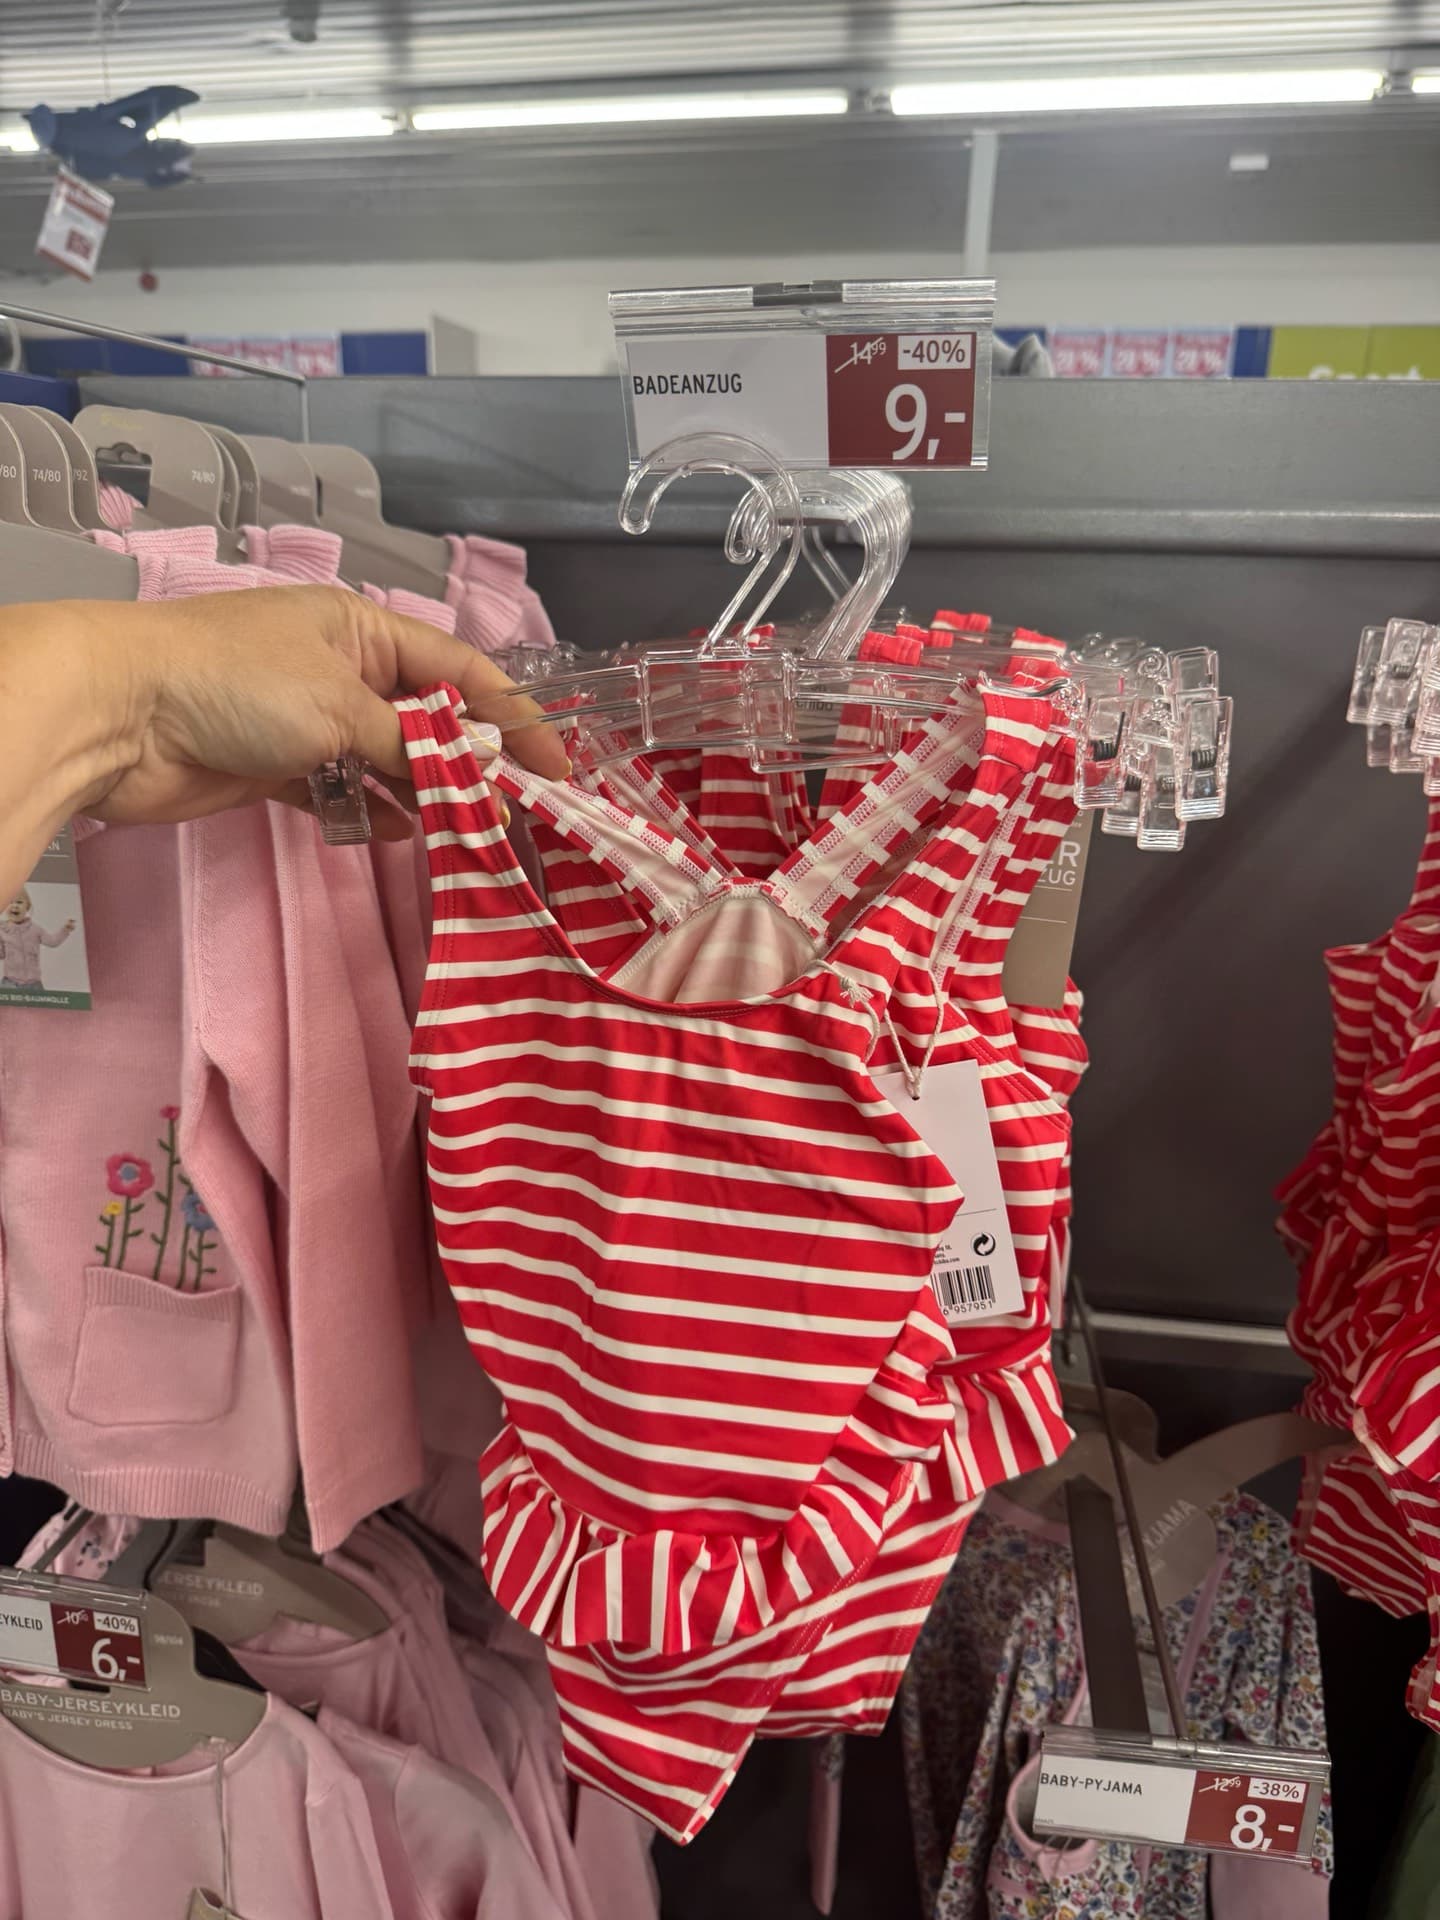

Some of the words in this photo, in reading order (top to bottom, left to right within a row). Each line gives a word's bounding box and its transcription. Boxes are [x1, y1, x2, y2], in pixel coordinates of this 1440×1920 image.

[902, 339, 966, 364] -40%
[633, 372, 743, 396] BADEANZUG
[884, 383, 967, 461] 9,-
[32, 468, 62, 482] 74/80
[96, 1615, 136, 1633] -40%
[91, 1637, 141, 1682] 6,-
[0, 1689, 181, 1719] BABY-JERSEYKLEID
[48, 1713, 91, 1726] JERSEY
[95, 1718, 133, 1731] DRESS
[1039, 1772, 1143, 1796] BABY-PYJAMA
[1252, 1782, 1300, 1800] -38%
[1230, 1804, 1295, 1852] 8,-
